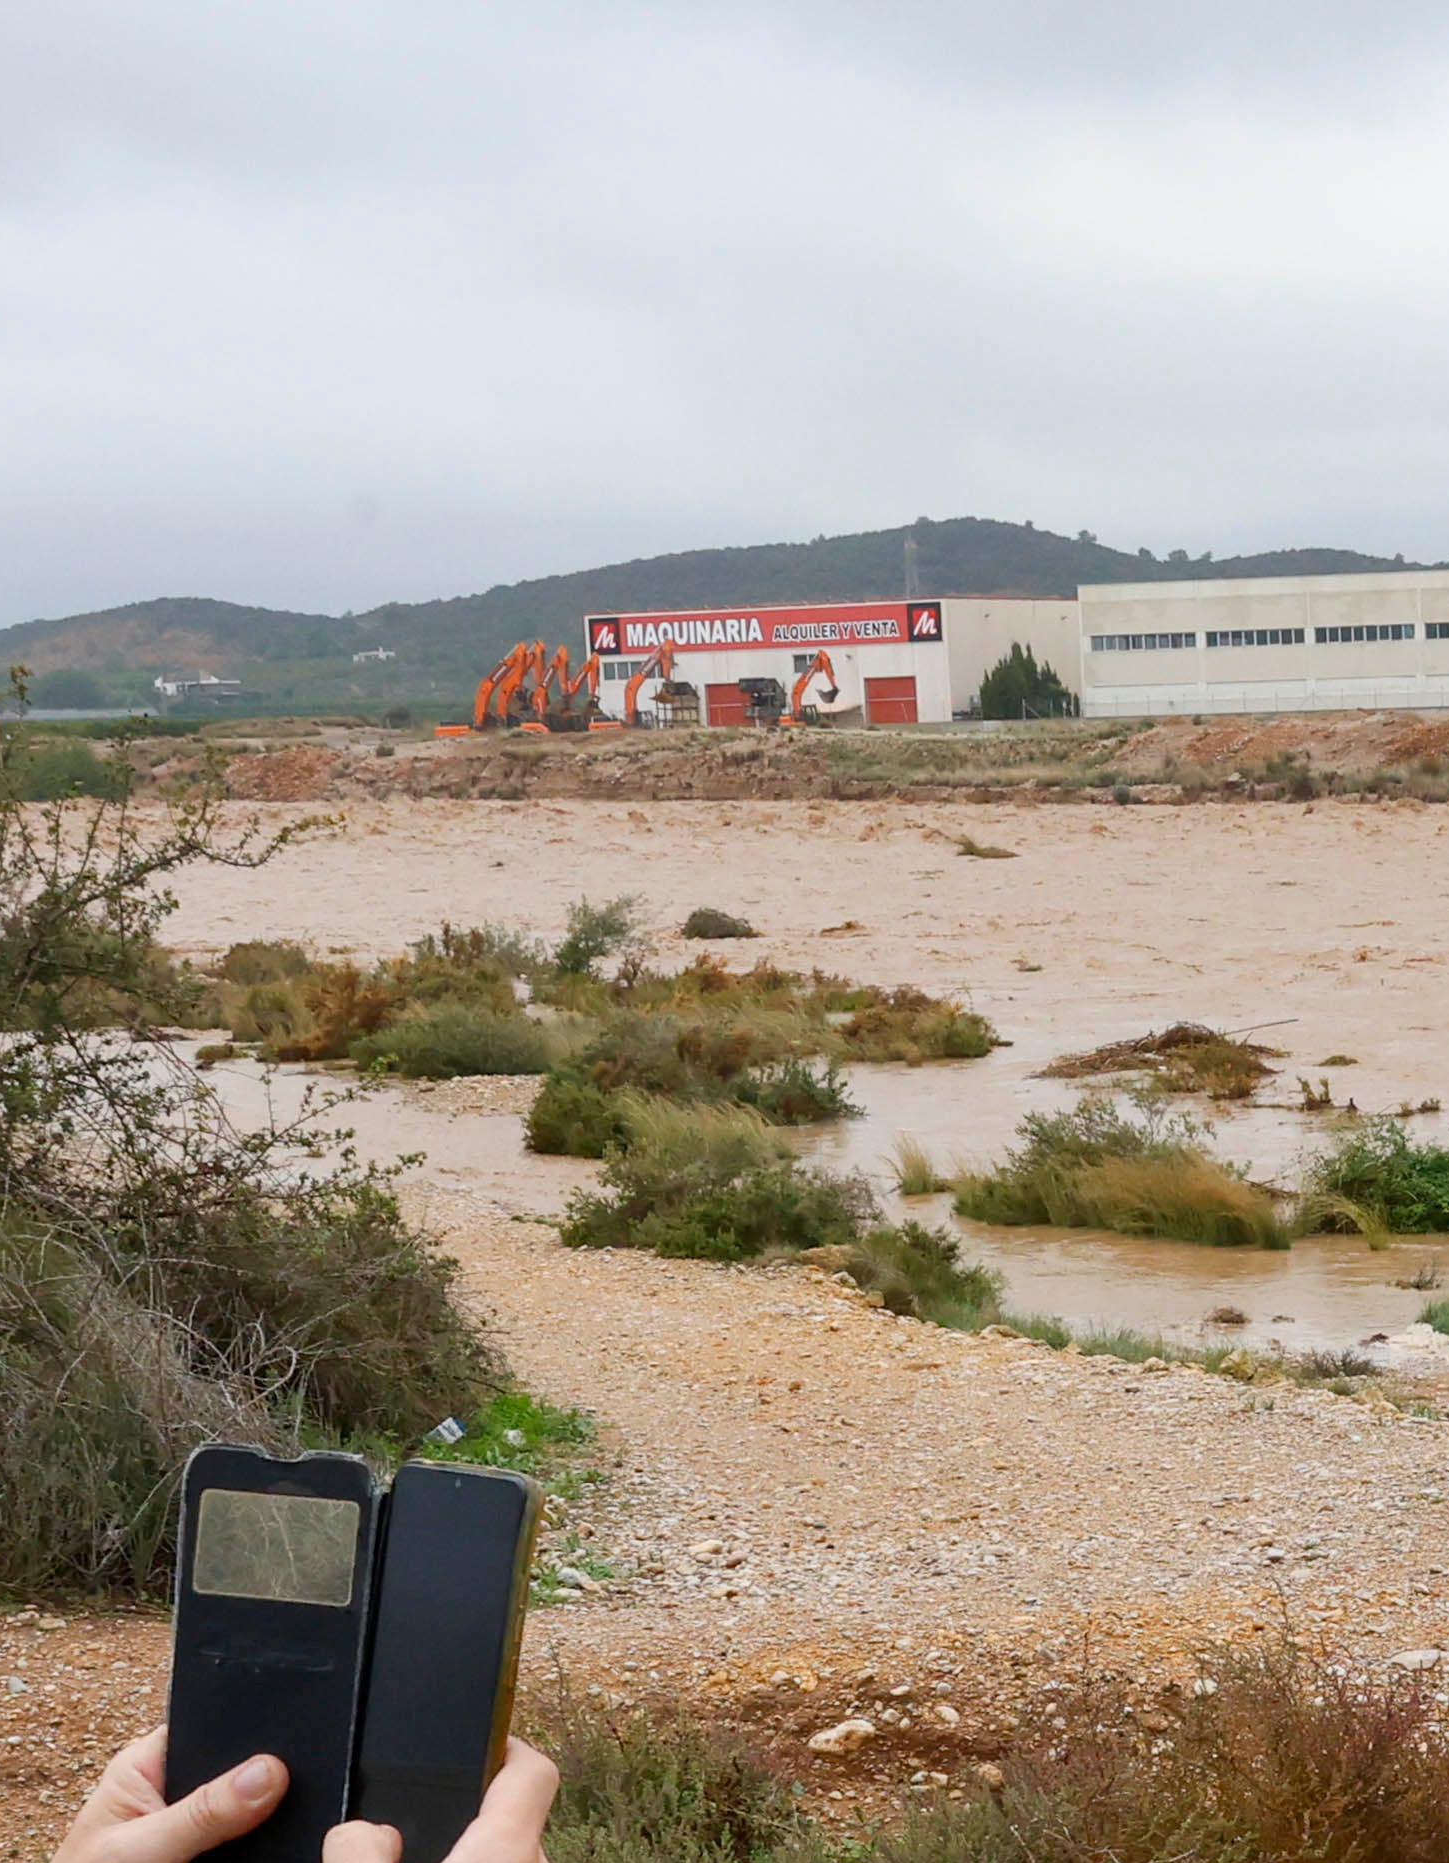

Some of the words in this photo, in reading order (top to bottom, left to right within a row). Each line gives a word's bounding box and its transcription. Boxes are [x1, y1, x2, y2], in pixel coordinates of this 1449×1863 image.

[625, 618, 763, 647] MAQUINARIA
[773, 622, 837, 642] ALQUILER
[841, 622, 851, 639] Y
[852, 619, 899, 638] VENTA
